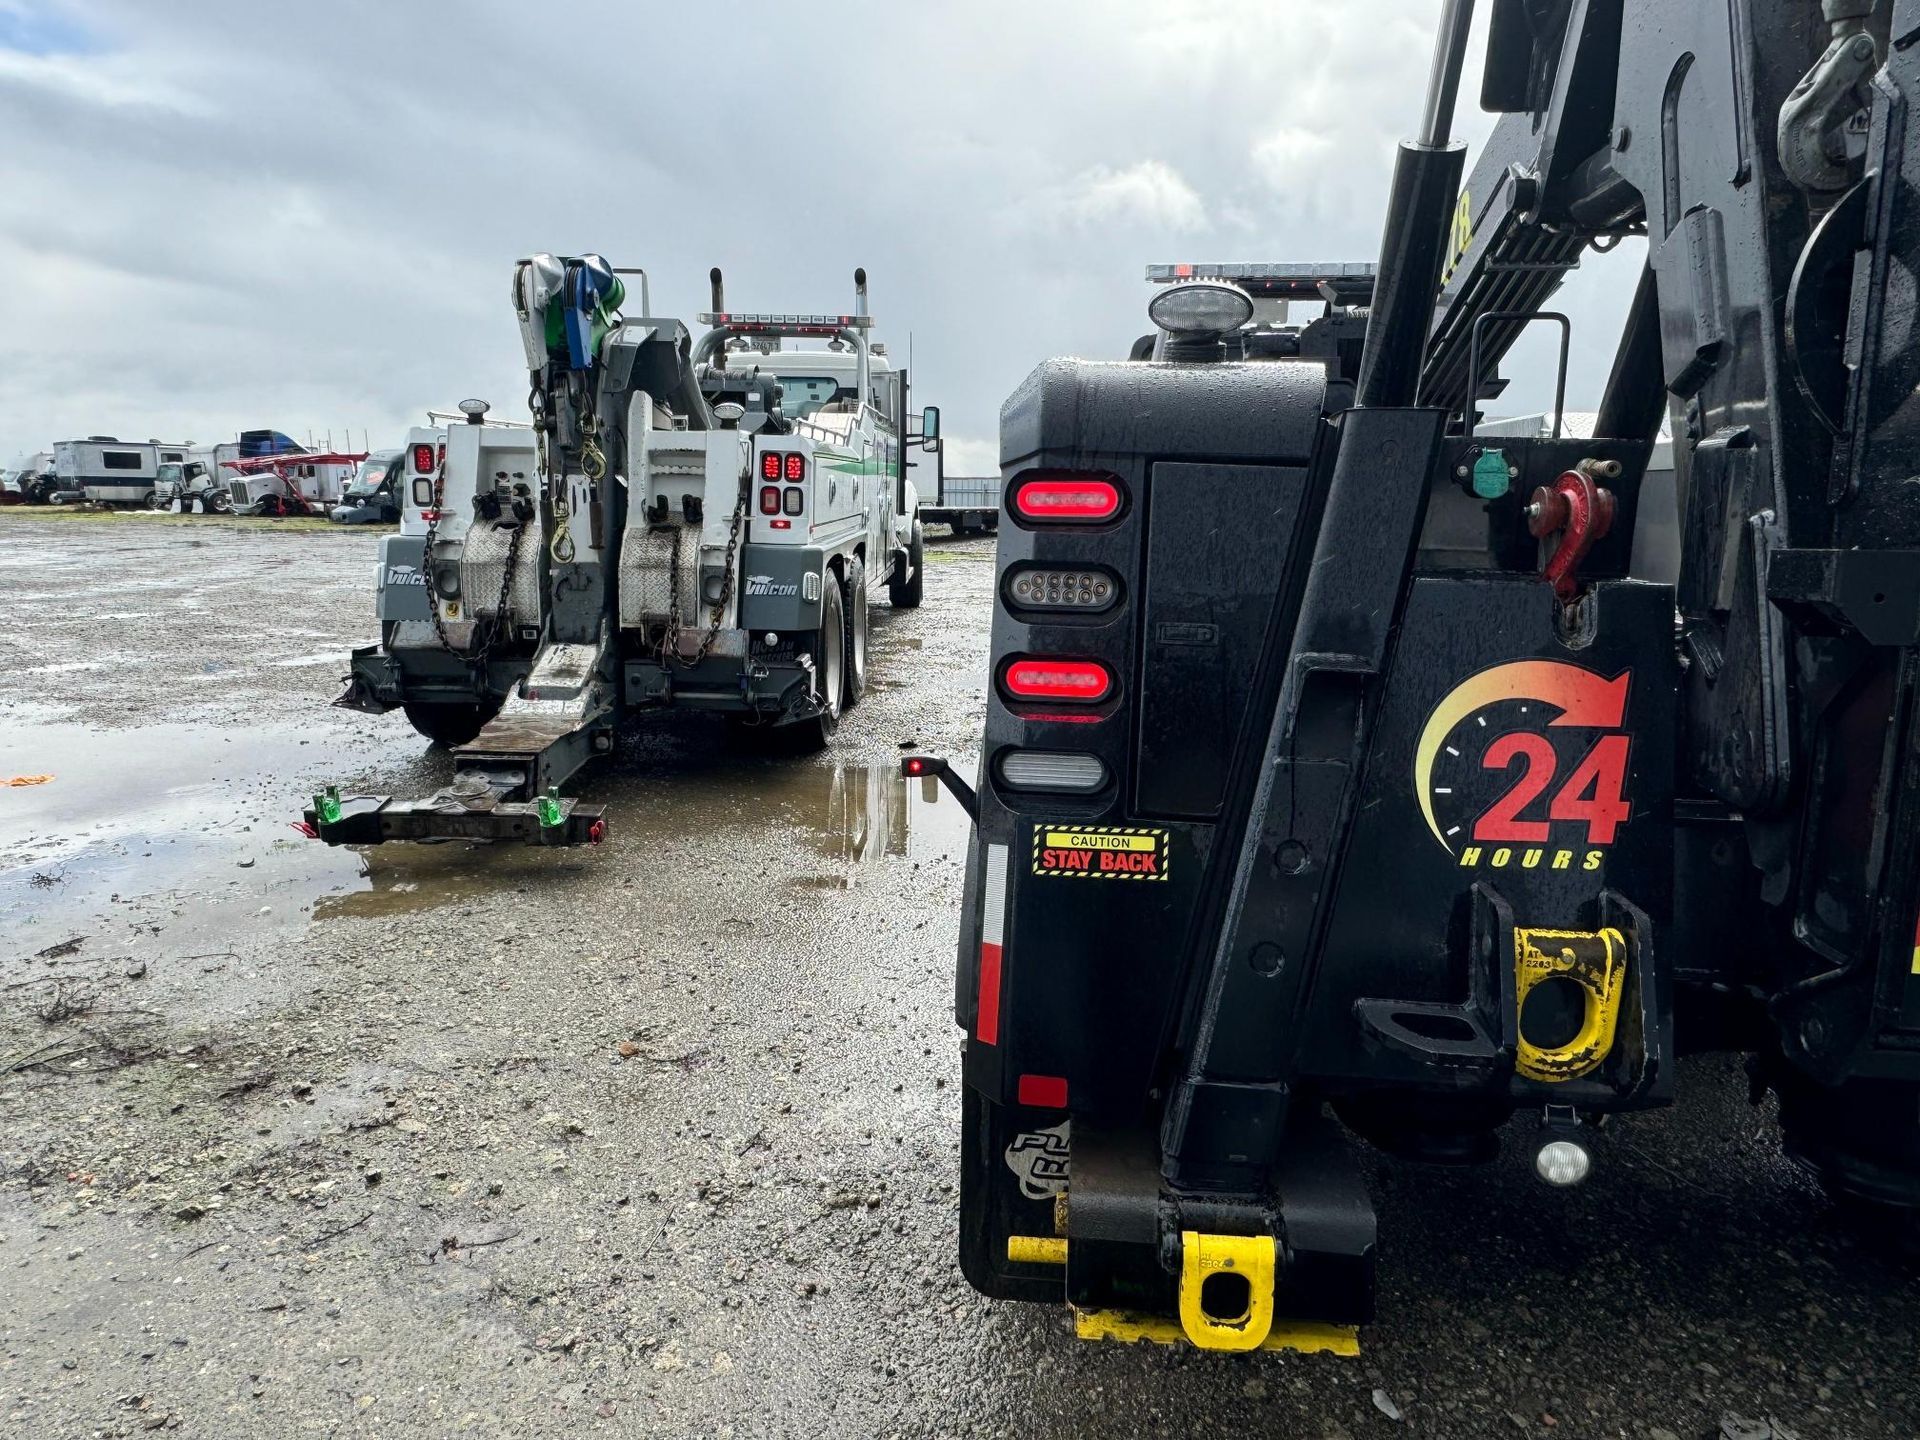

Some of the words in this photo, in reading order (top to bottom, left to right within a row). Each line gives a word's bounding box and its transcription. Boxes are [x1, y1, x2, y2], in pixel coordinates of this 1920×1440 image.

[1474, 732, 1631, 844] 24
[1070, 835, 1130, 849] CAUTION
[1042, 850, 1091, 871] STAY
[1100, 851, 1157, 873] BACK
[1459, 847, 1603, 871] HOURS
